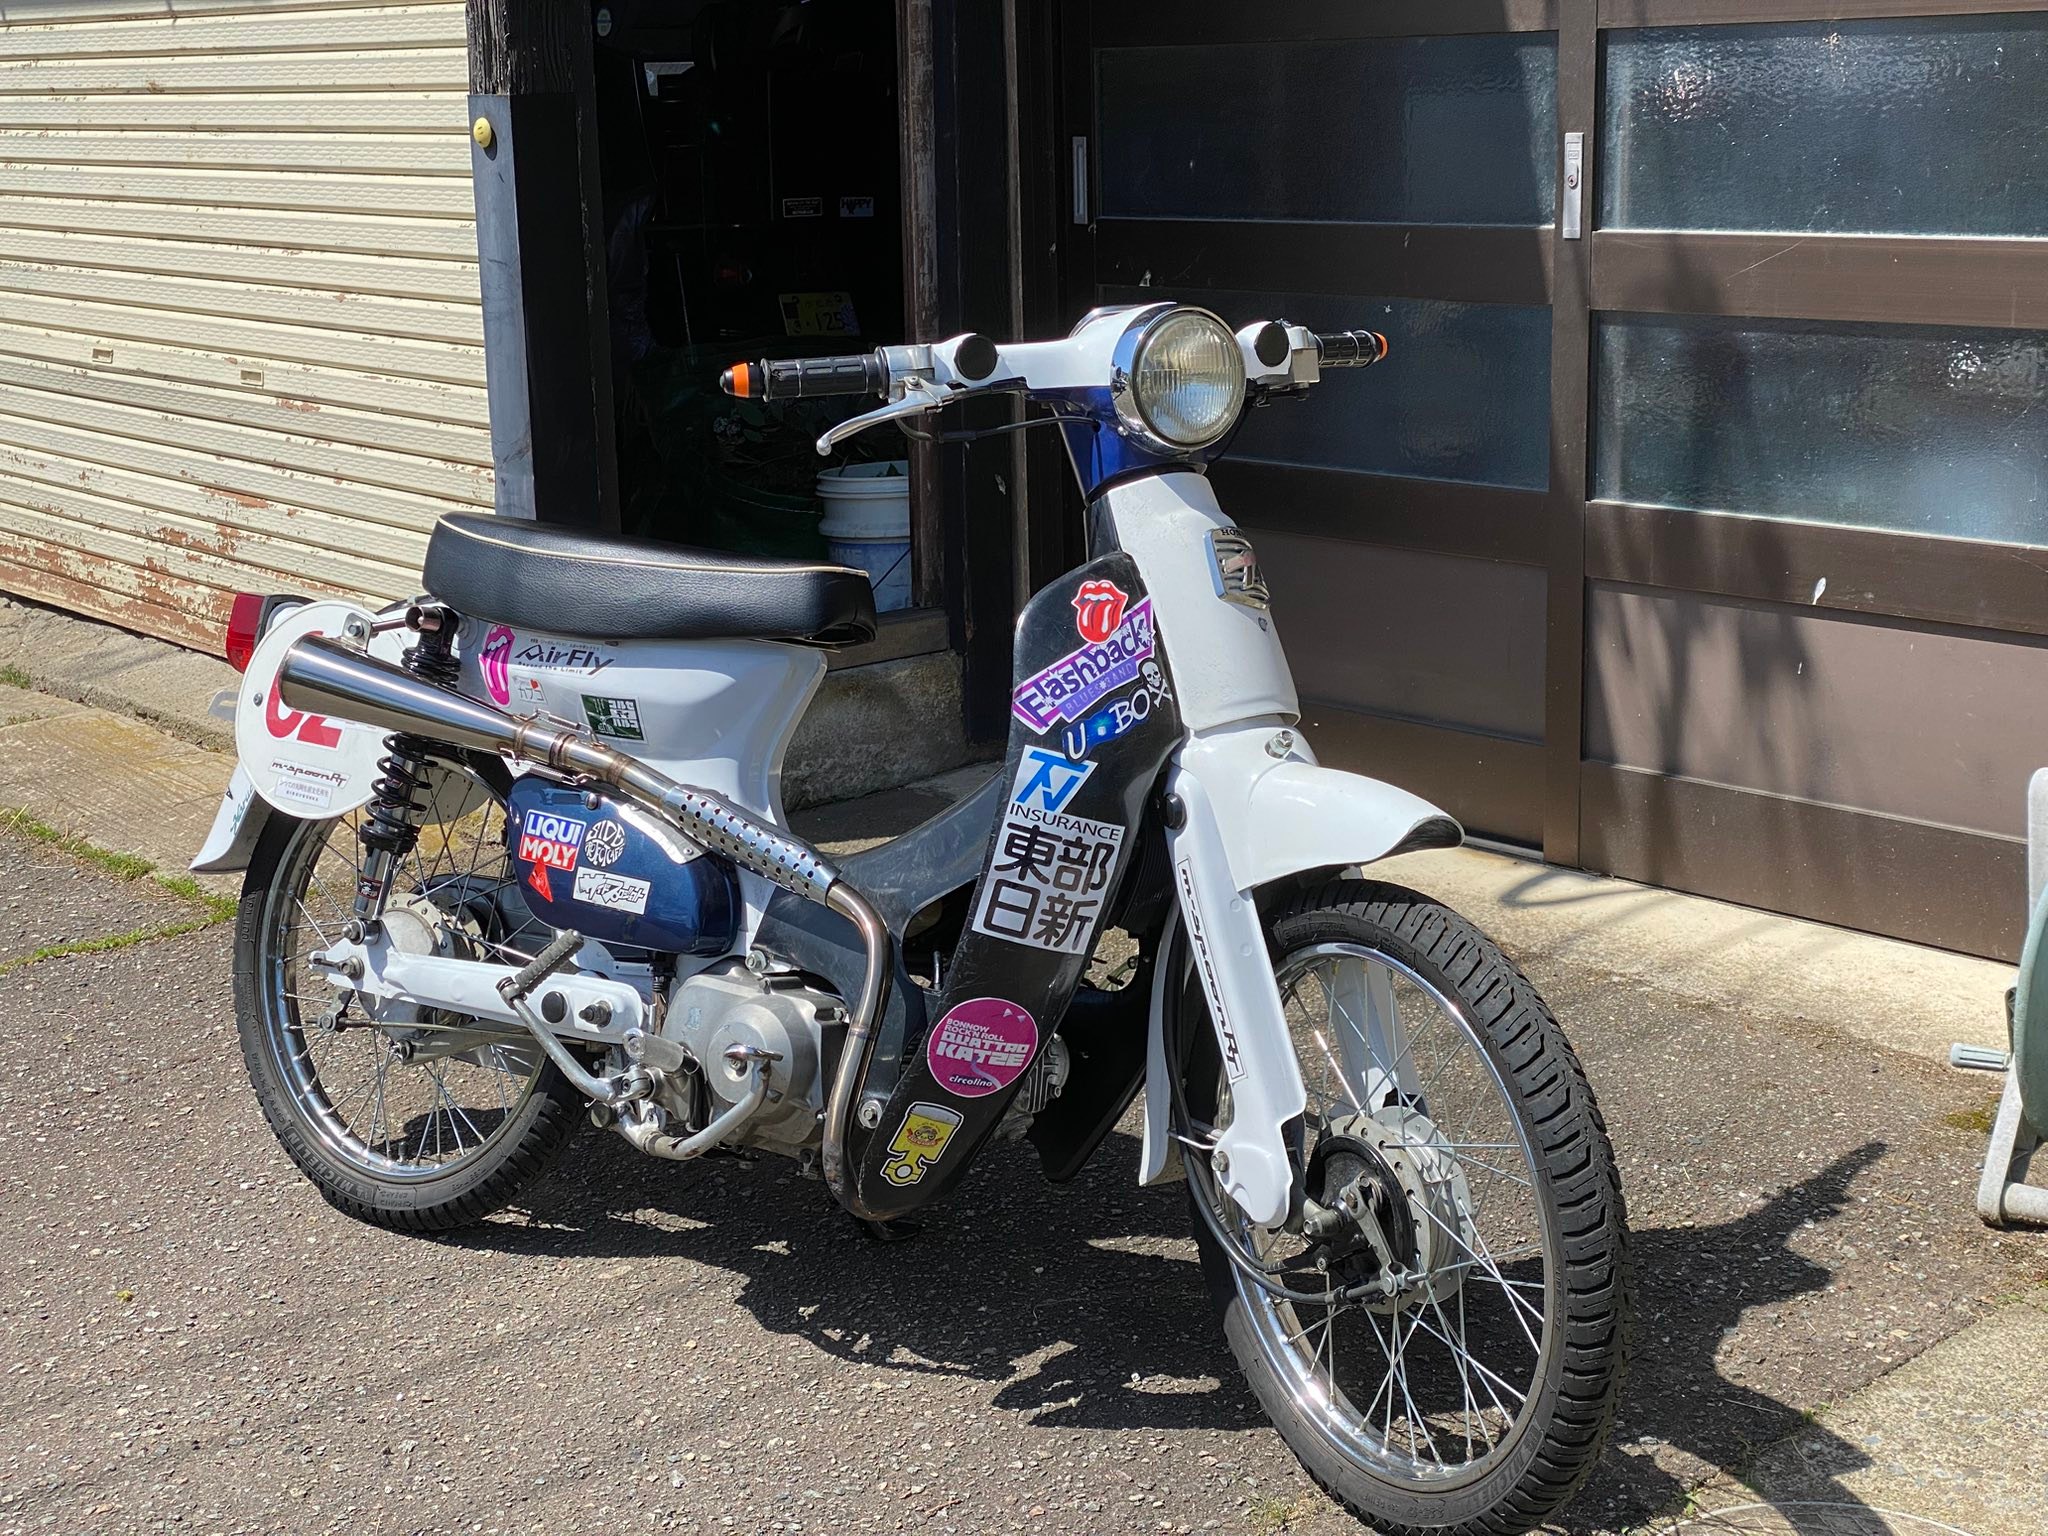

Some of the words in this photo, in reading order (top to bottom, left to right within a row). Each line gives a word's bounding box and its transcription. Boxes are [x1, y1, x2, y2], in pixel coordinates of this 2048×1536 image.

[514, 644, 615, 675] AirFly
[1018, 613, 1151, 728] Flashback
[1065, 685, 1101, 713] BLUES
[1105, 662, 1134, 687] BAND
[526, 814, 582, 845] LIQUI
[586, 820, 626, 847] SIDE
[1010, 803, 1121, 841] INSURANCE
[521, 837, 577, 867] MOLY
[994, 822, 1115, 895] 東部
[983, 879, 1098, 950] 日新
[946, 1018, 990, 1033] BONNOW
[981, 1032, 1005, 1042] ROLL
[936, 1041, 1026, 1067] KATZE
[940, 1031, 1030, 1053] QUATTRO
[949, 1076, 993, 1087] circolino
[286, 1131, 353, 1192] MICHELIN
